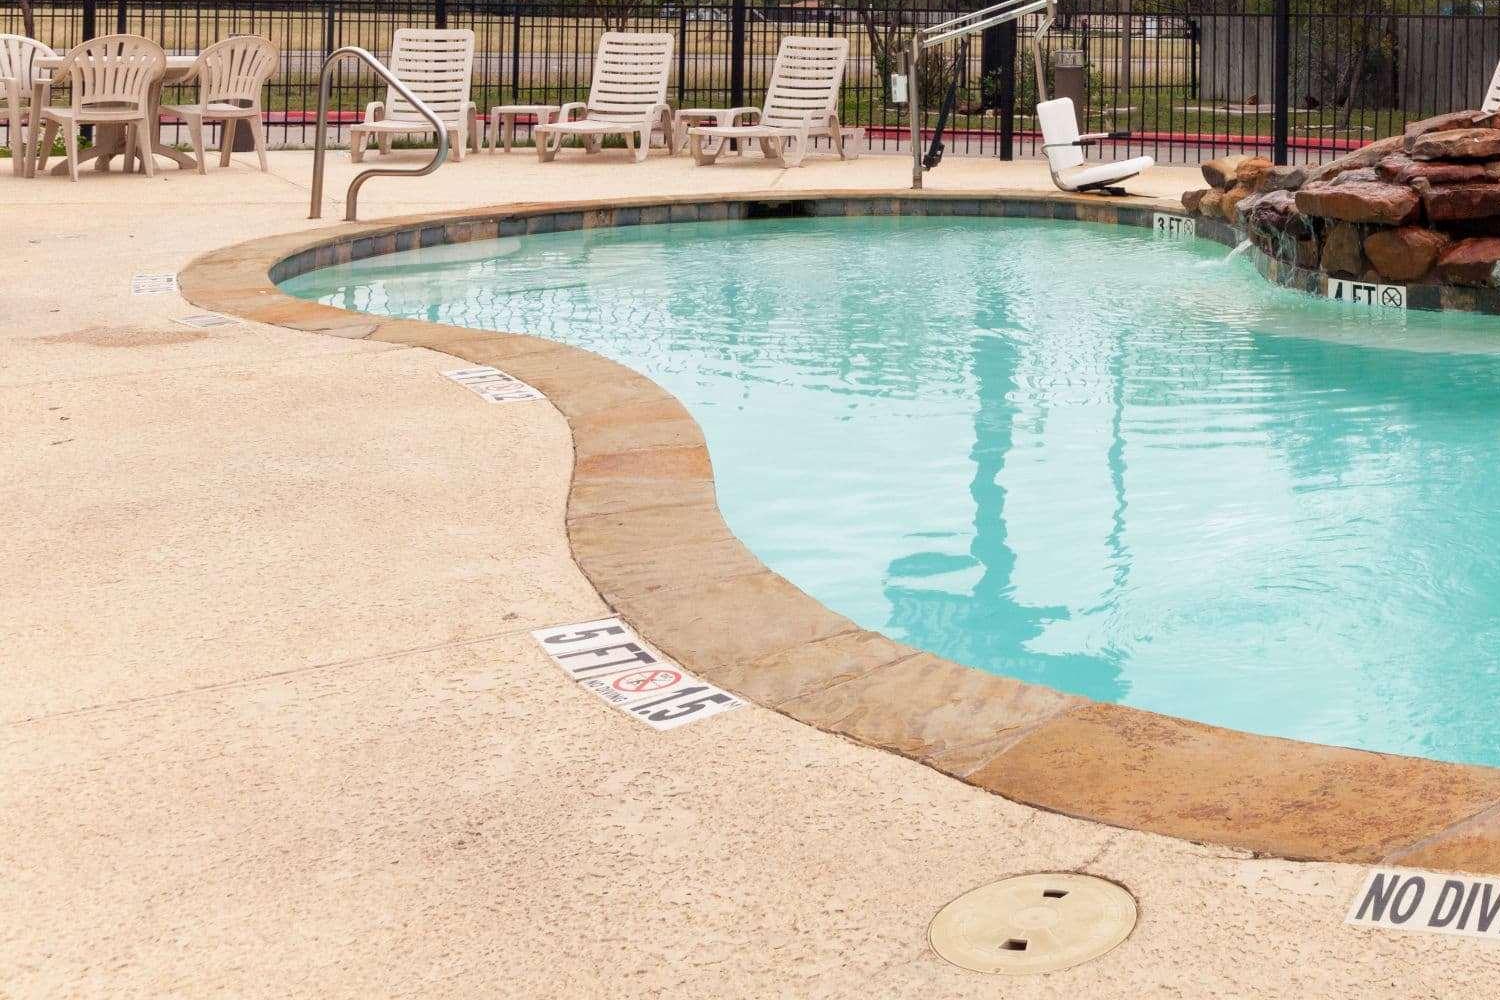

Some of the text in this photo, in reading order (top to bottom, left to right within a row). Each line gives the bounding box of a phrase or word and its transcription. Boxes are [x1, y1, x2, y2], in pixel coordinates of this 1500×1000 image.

[1169, 216, 1182, 232] FT
[1352, 283, 1376, 305] FT
[544, 625, 657, 673] 5 FT
[630, 685, 732, 722] 1.5
[1354, 873, 1426, 925] NO
